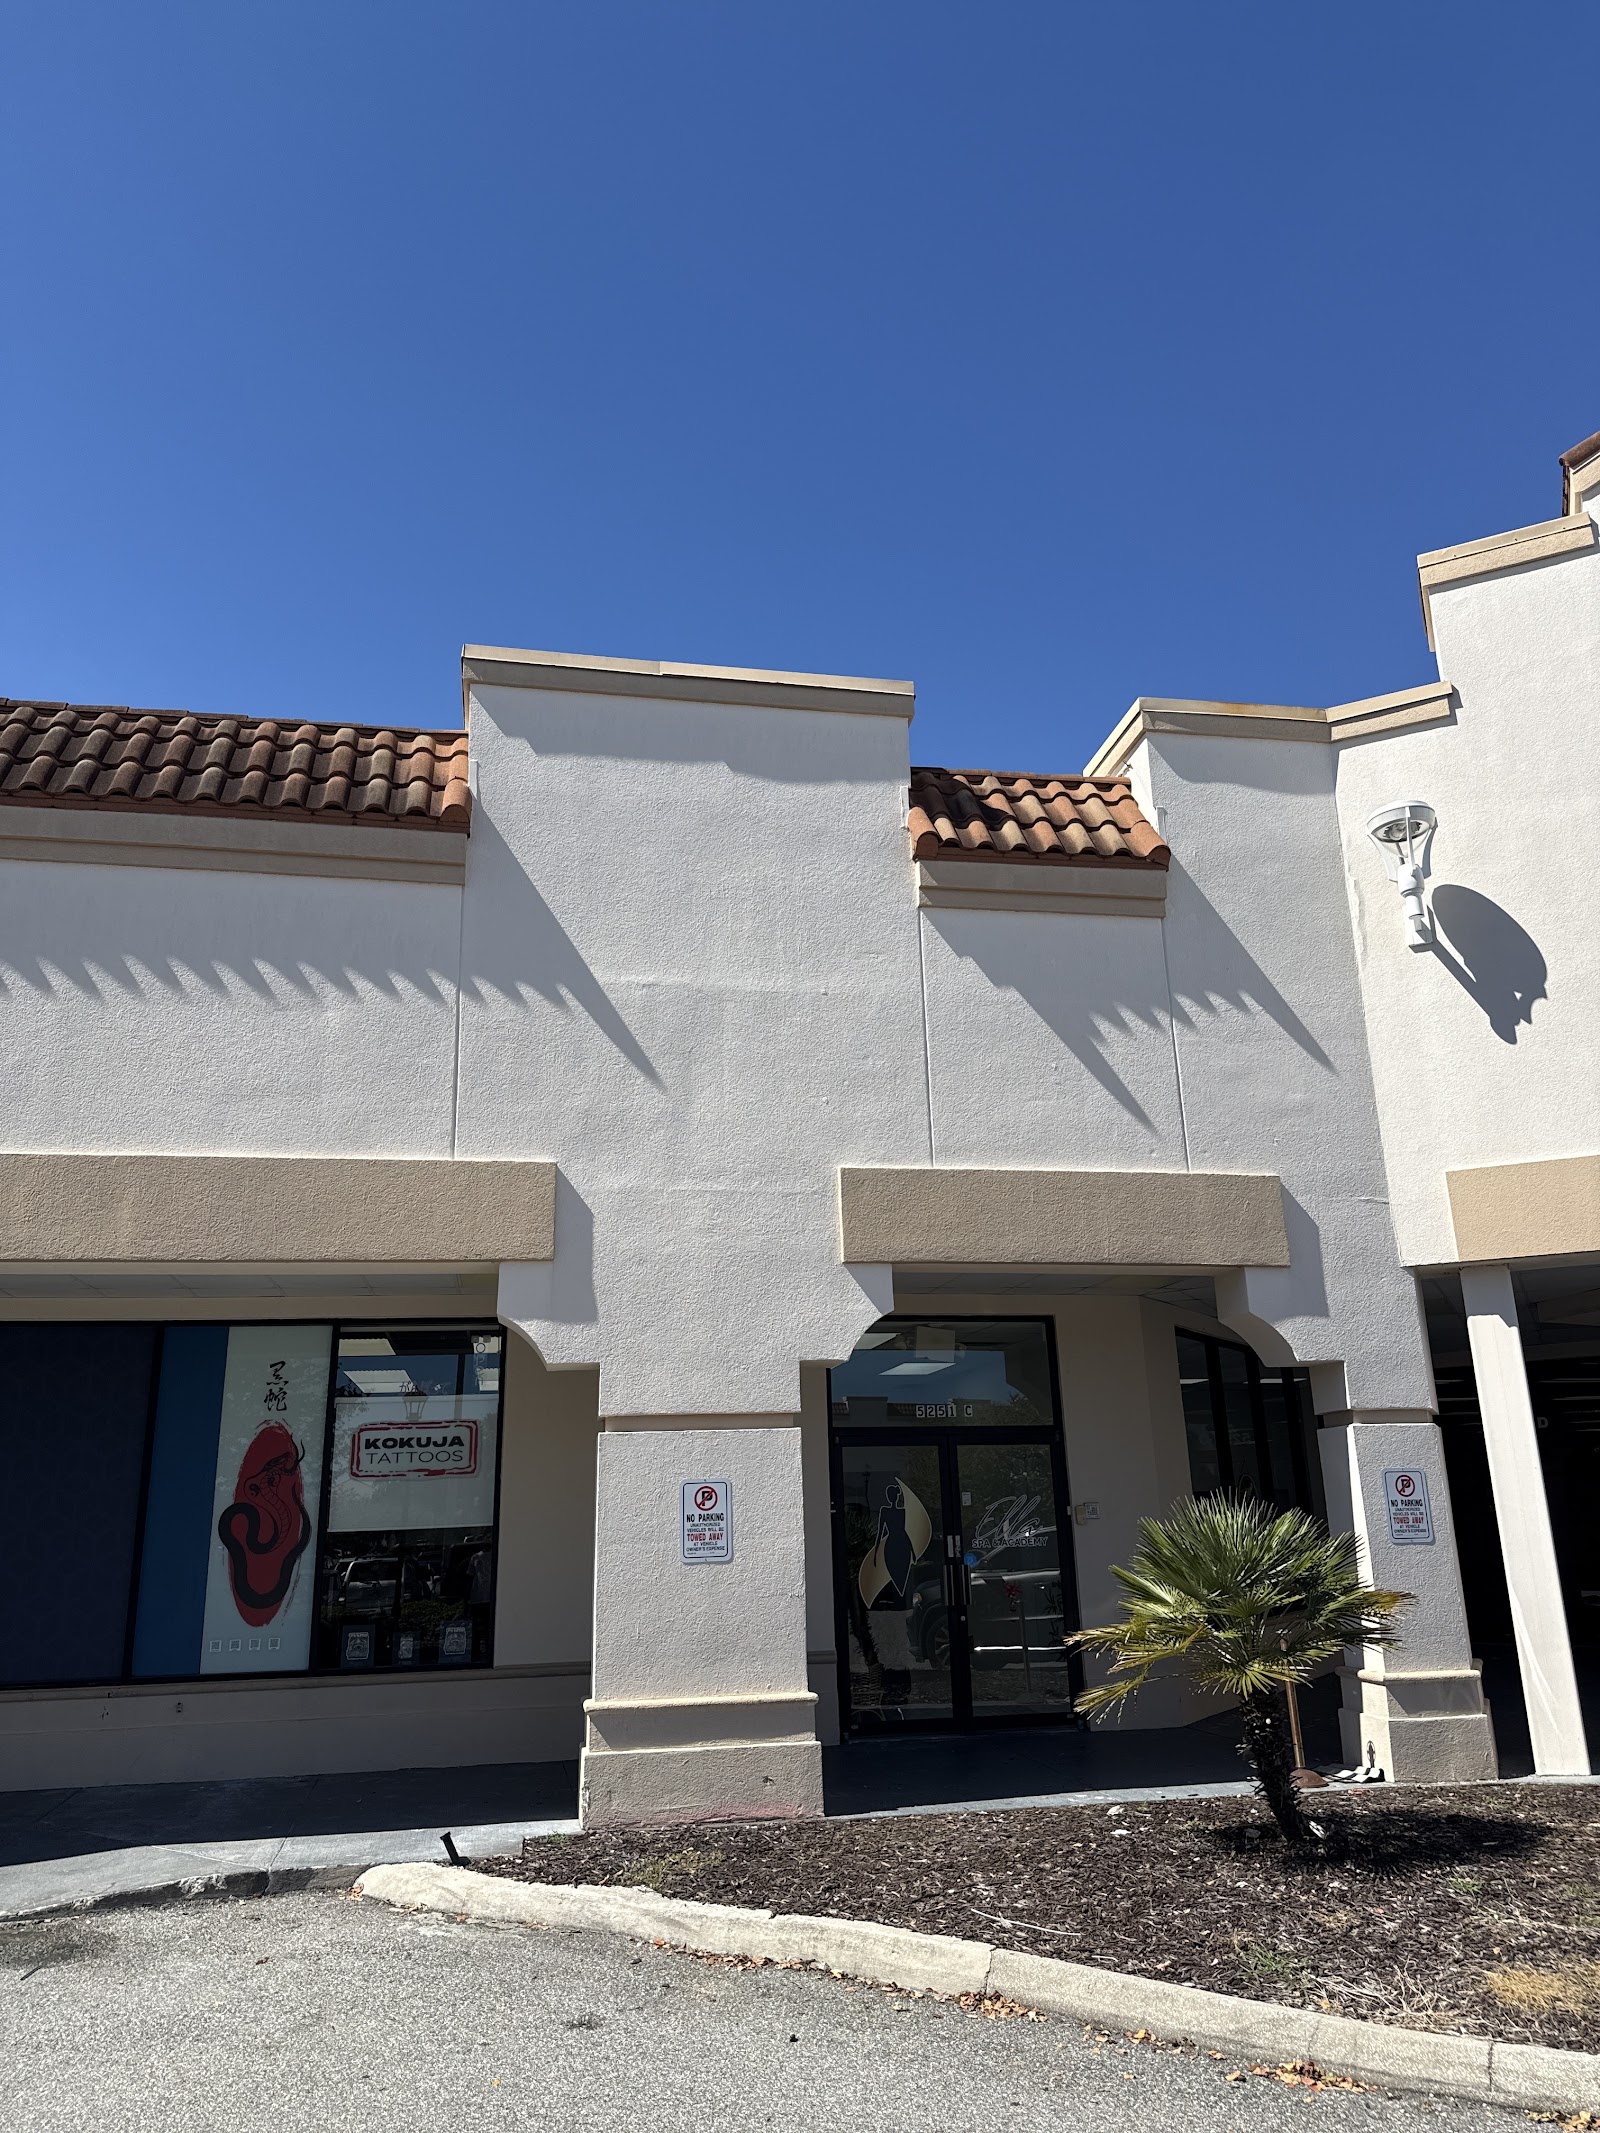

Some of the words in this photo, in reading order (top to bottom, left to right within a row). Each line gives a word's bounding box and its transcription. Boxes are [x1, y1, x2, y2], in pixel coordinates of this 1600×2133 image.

[916, 1405, 955, 1417] 5251
[964, 1405, 972, 1416] C
[1536, 1416, 1549, 1429] D
[364, 1435, 465, 1450] KOKUJA
[365, 1450, 464, 1465] TATTOOS
[1390, 1499, 1398, 1507] NO
[1400, 1499, 1423, 1507] PARKING
[686, 1514, 695, 1522] NO
[698, 1513, 725, 1522] PARKING
[975, 1494, 1044, 1540] Ella
[687, 1533, 706, 1541] TOWED
[709, 1533, 724, 1541] AWAY
[971, 1538, 991, 1549] SPA
[992, 1538, 1001, 1548] &
[1001, 1536, 1048, 1548] ACADEMY
